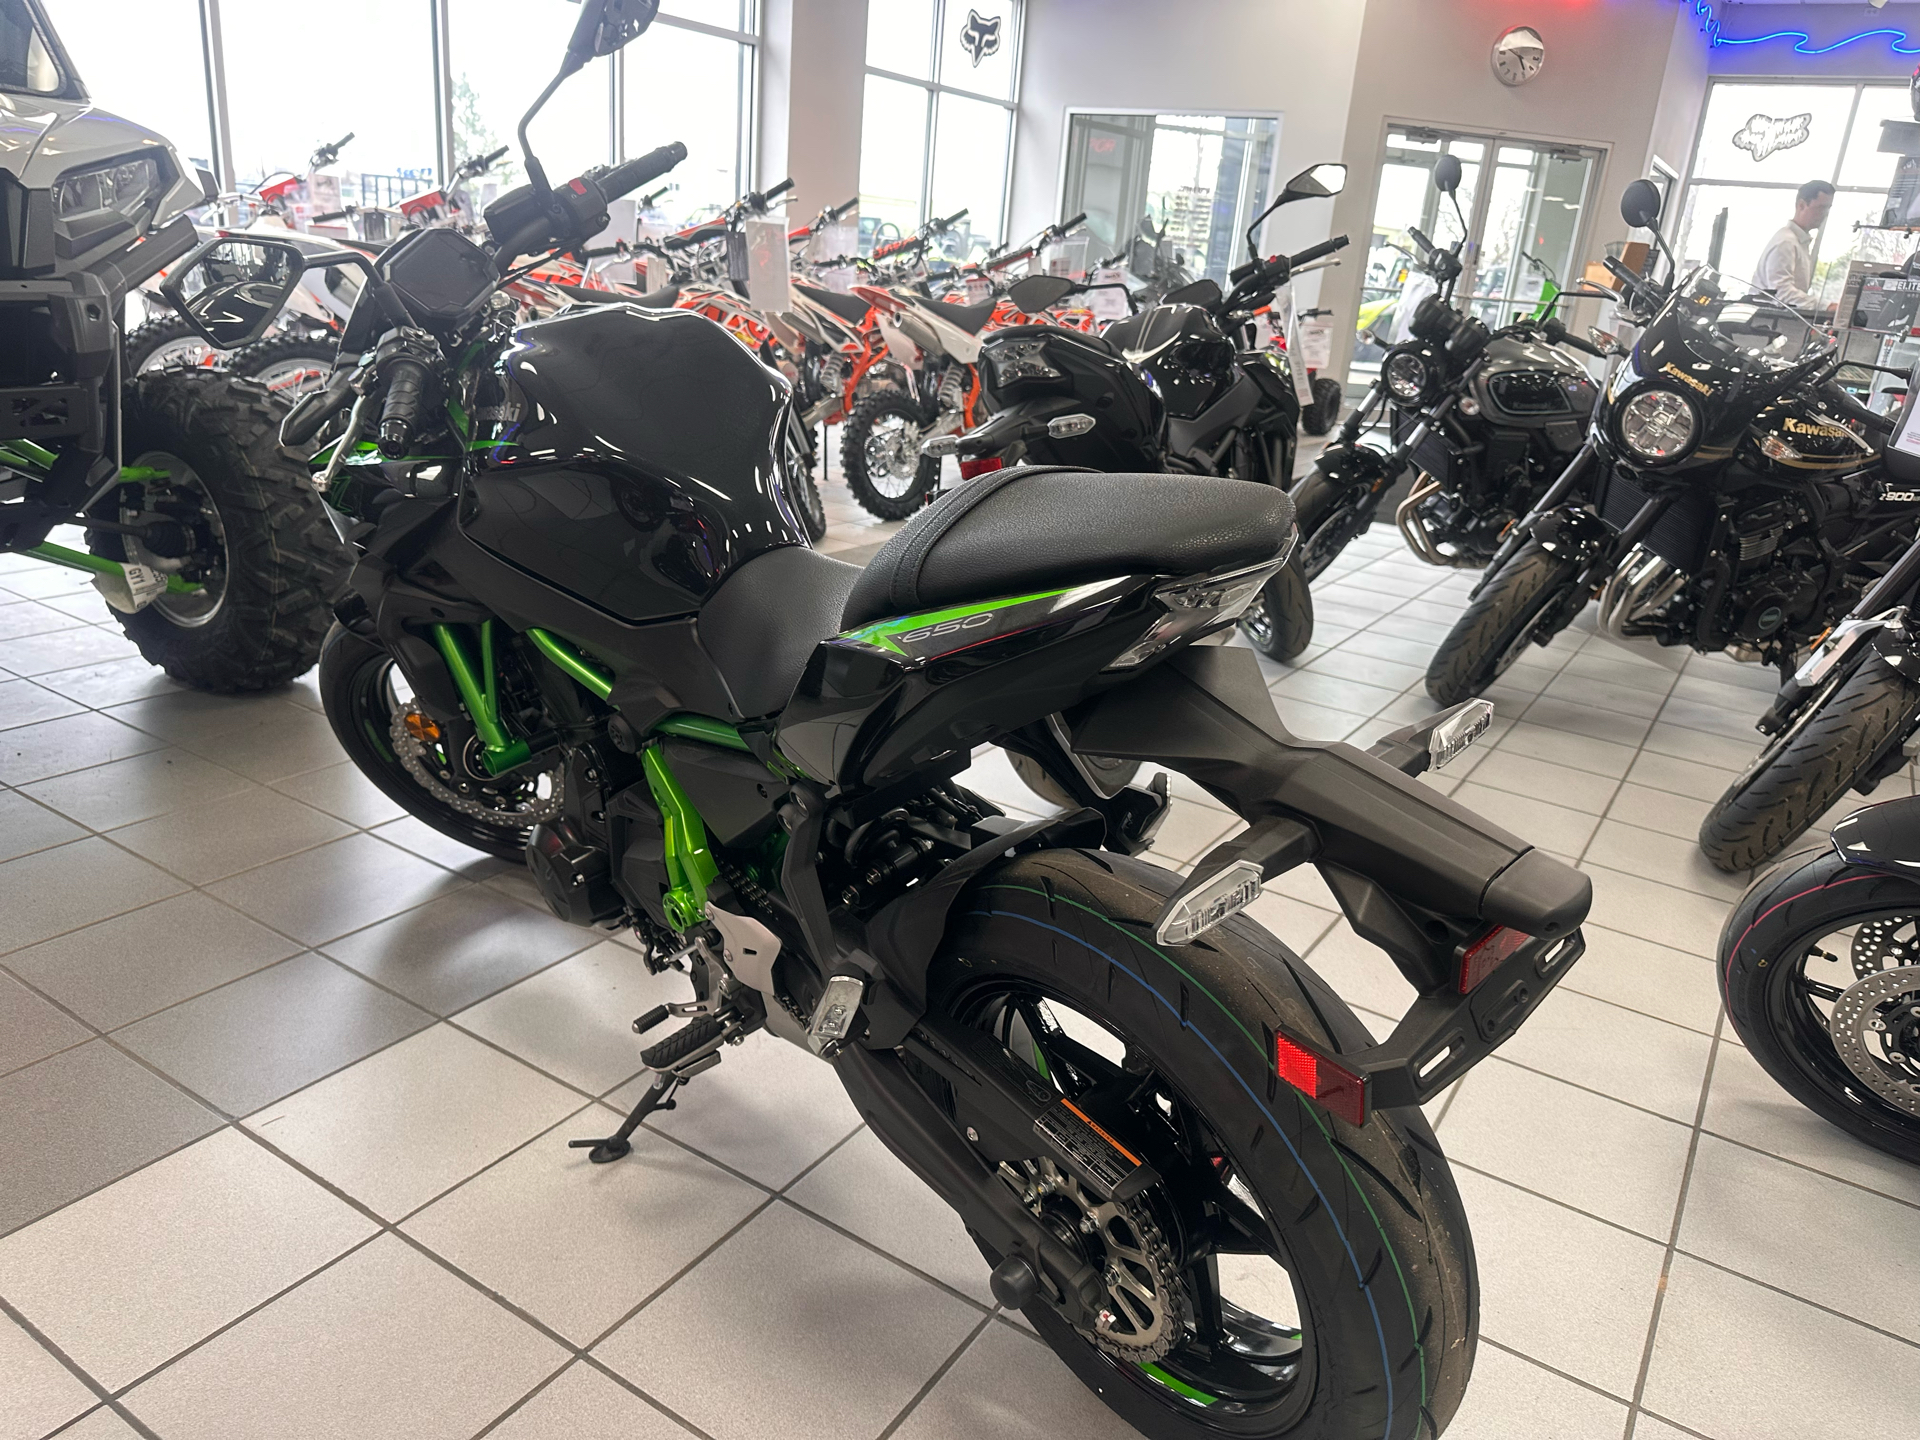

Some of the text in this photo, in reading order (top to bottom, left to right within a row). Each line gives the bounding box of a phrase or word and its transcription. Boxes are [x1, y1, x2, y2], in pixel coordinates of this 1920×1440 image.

[1665, 361, 1715, 397] Kawasaki
[1782, 417, 1850, 438] Kawasa
[902, 612, 994, 643] 650
[1091, 1123, 1115, 1143] WARNING
